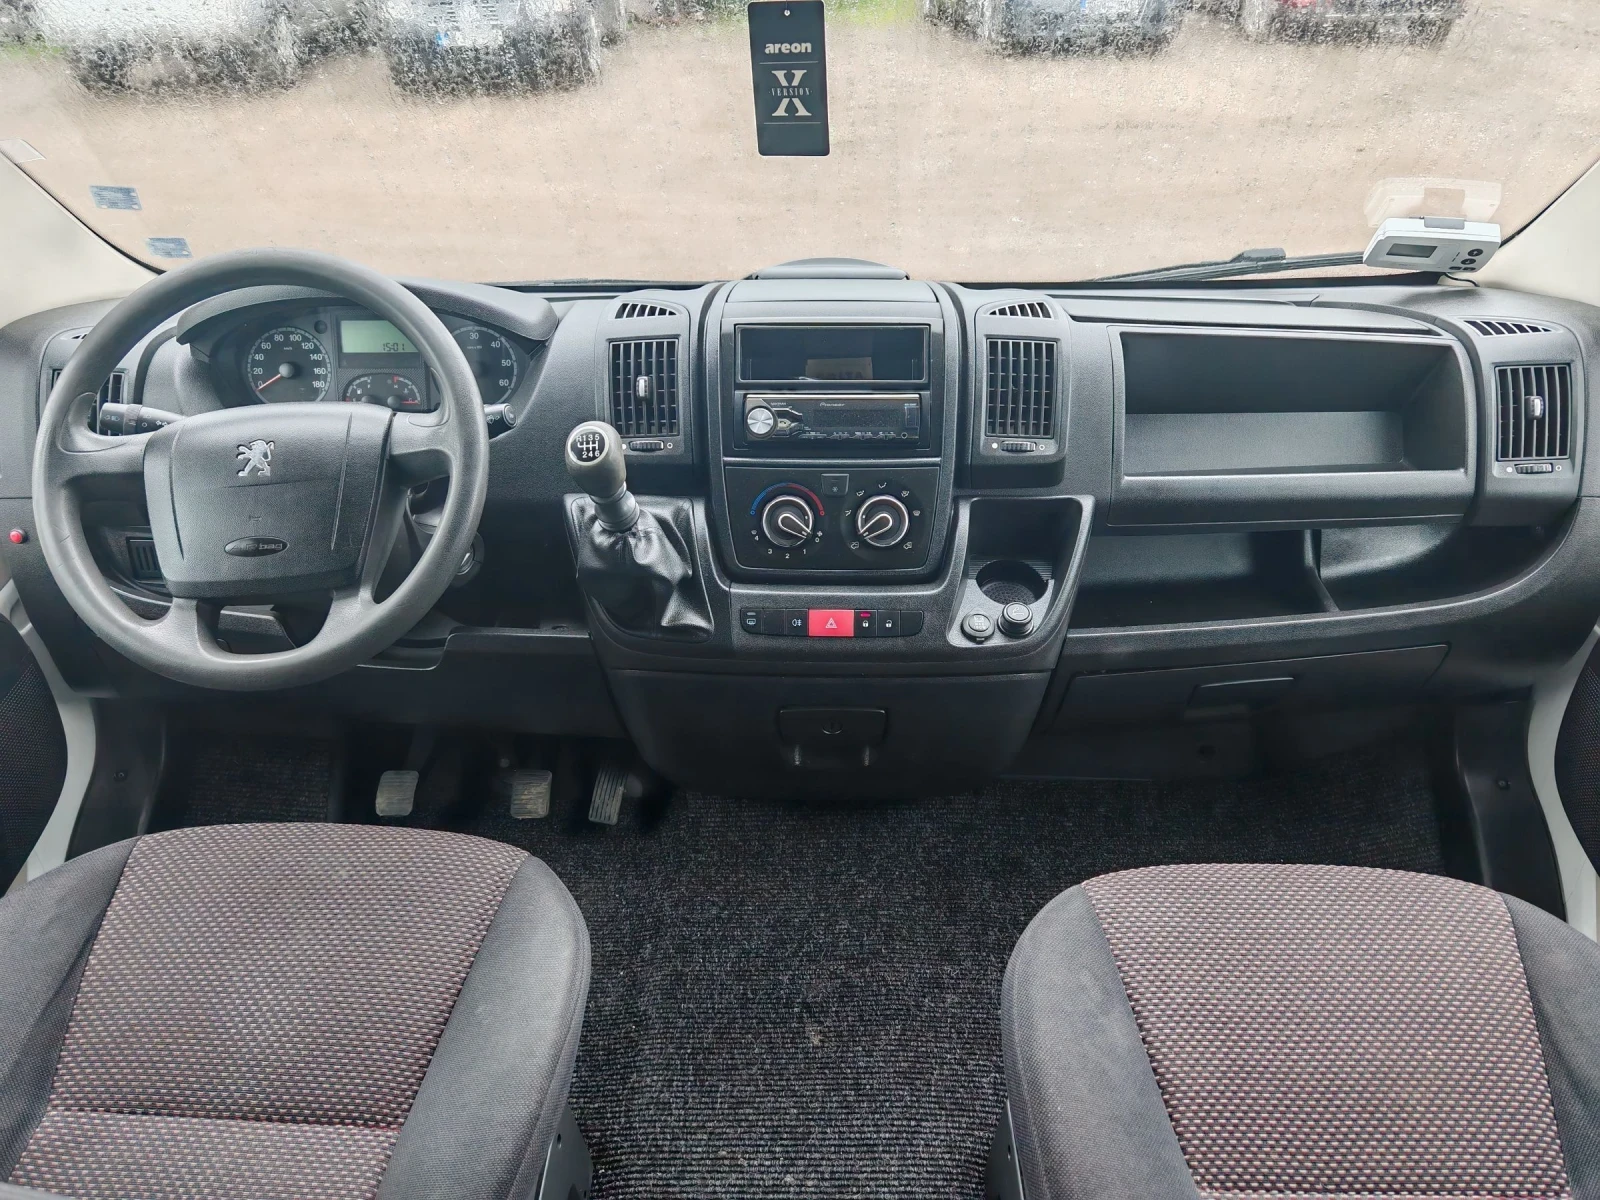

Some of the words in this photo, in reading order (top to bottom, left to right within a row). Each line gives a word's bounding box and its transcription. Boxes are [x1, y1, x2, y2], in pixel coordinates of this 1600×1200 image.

[765, 42, 812, 54] areon
[770, 87, 810, 97] VERSION
[274, 334, 284, 342] 80
[289, 334, 302, 342] 100
[469, 332, 479, 340] 30
[261, 342, 272, 350] 60
[301, 342, 314, 350] 120
[254, 353, 264, 361] 40
[309, 353, 323, 361] 140
[501, 359, 511, 367] 50
[253, 367, 263, 375] 20
[313, 367, 326, 375] 160
[312, 380, 325, 388] 180
[499, 378, 509, 386] 60
